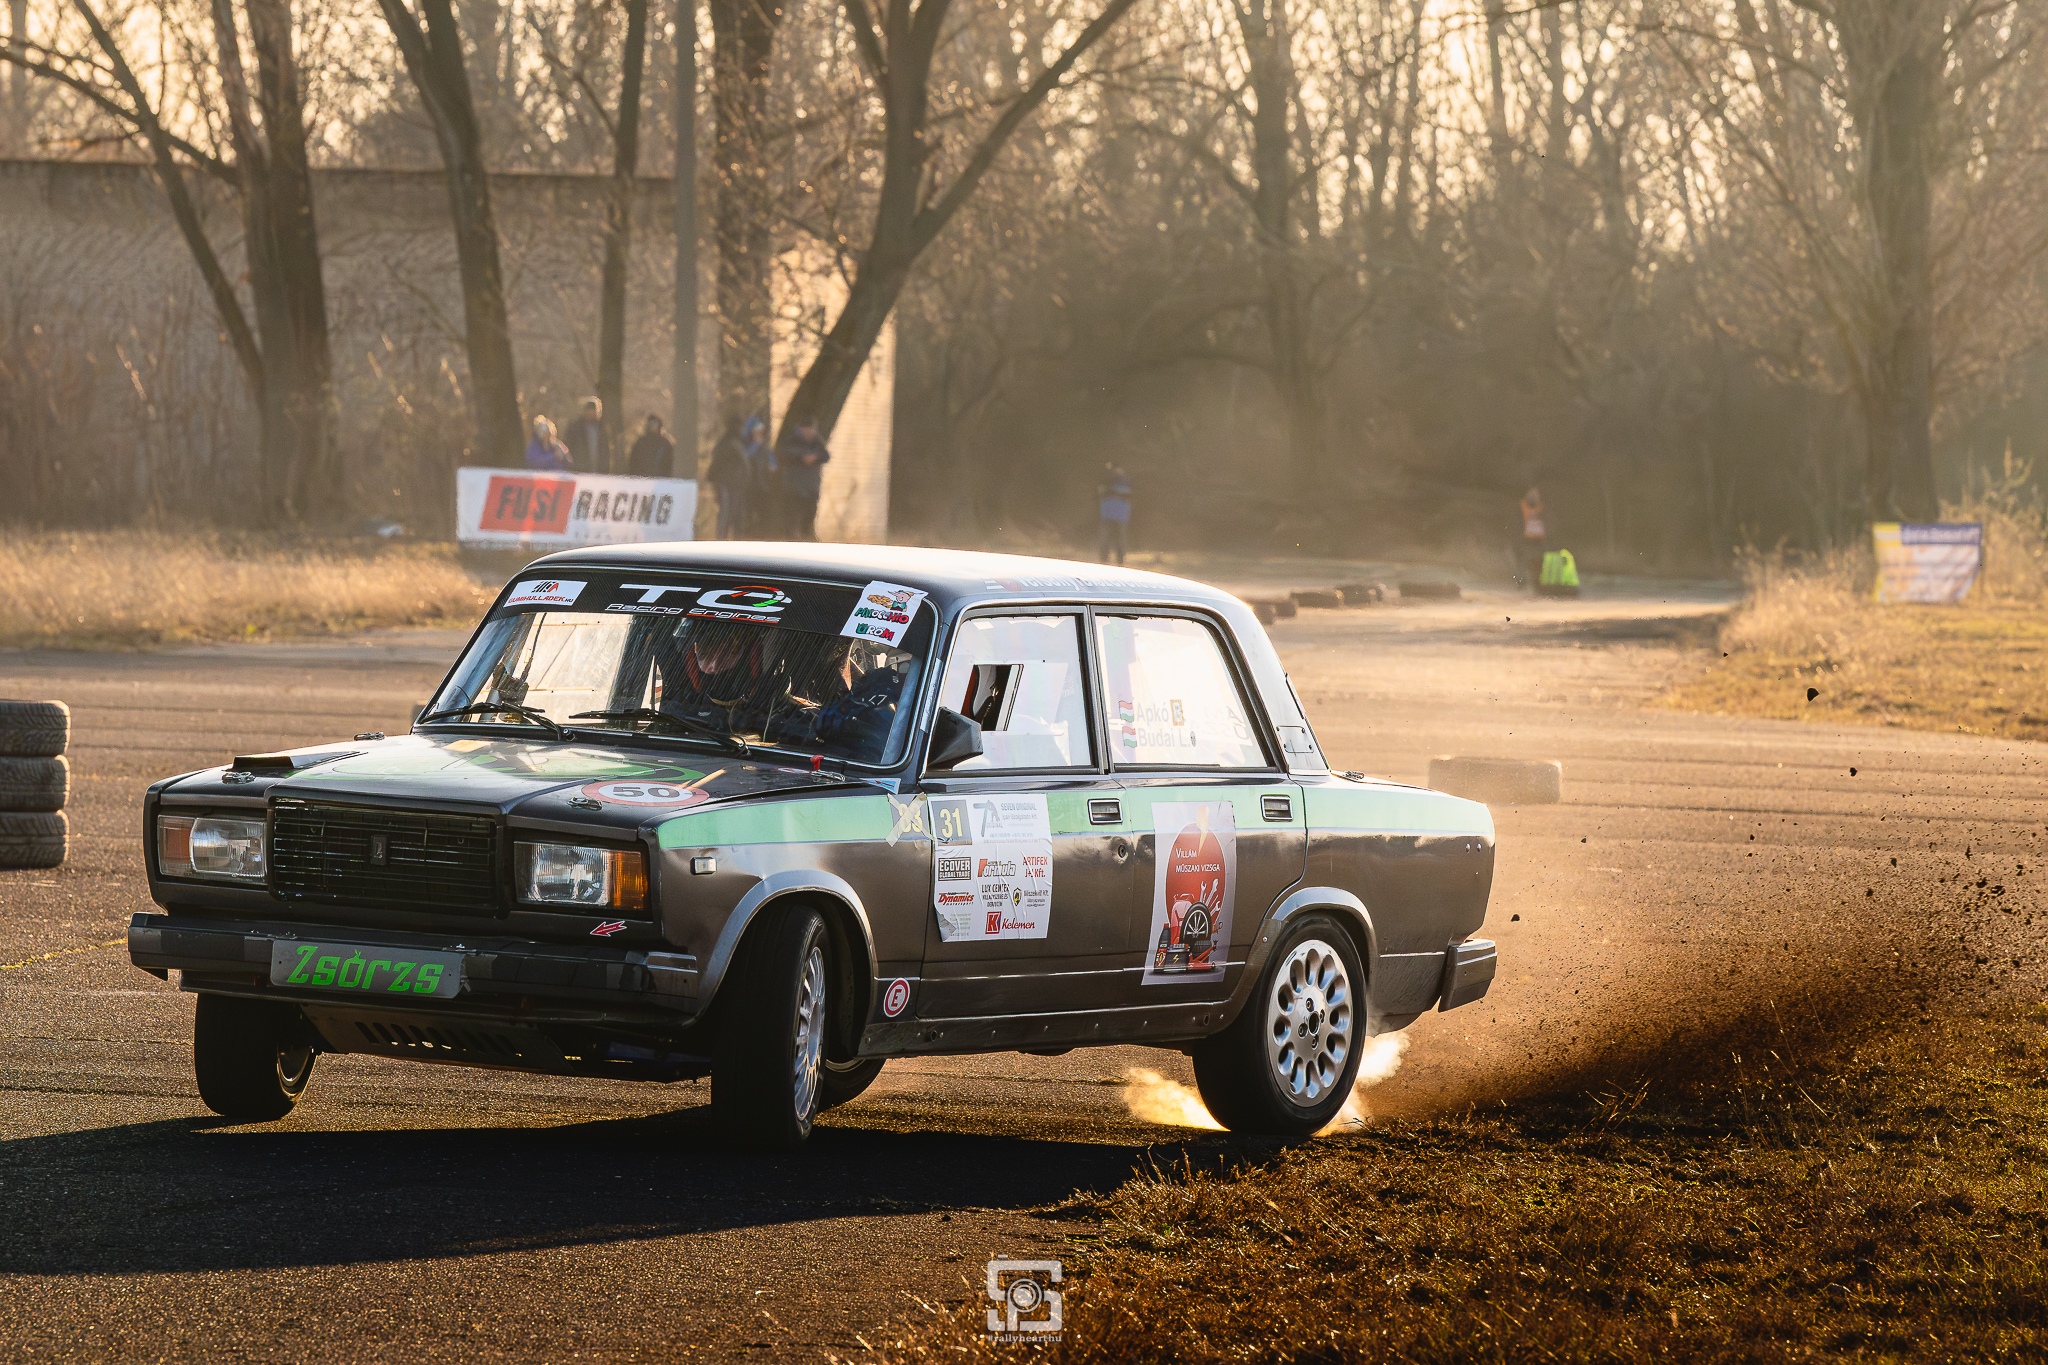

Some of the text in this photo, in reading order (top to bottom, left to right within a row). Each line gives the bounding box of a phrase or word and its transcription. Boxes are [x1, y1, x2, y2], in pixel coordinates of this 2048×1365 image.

[495, 485, 674, 525] FUSI RACING
[604, 603, 782, 623] Racing Engines
[854, 607, 910, 624] PINOCCHIO
[855, 623, 895, 641] ÜRÖM
[1136, 702, 1169, 726] Apkó
[1138, 727, 1191, 748] Budai L.
[612, 786, 681, 799] 50
[1000, 803, 1015, 811] SEVEN
[939, 807, 963, 837] 31
[939, 860, 971, 871] ECOVER
[1022, 856, 1048, 866] ARTIFEX
[1201, 863, 1221, 872] VIZSGA
[1034, 868, 1046, 878] Kft.
[938, 893, 974, 905] Dynamics
[1002, 917, 1036, 930] Kelemen
[890, 988, 902, 1007] E
